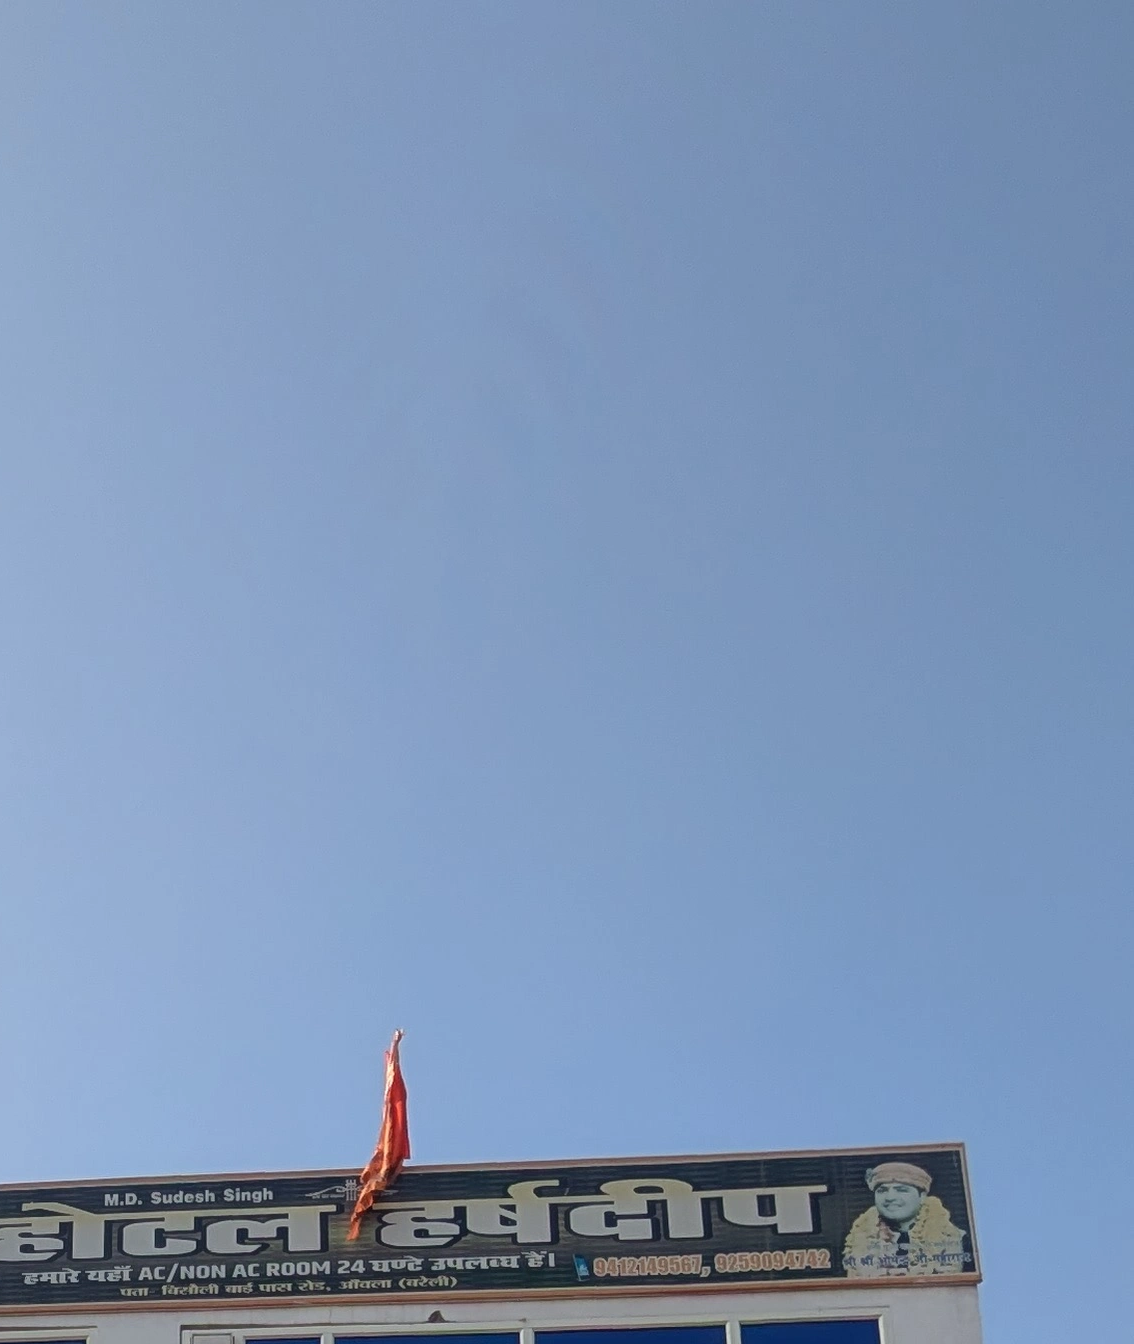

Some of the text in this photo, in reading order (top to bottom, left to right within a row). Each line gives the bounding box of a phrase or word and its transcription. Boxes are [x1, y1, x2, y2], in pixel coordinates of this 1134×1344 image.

[104, 1188, 273, 1207] M.D. Sudesh Singh
[372, 1178, 827, 1246] हर्षदीप
[22, 1267, 81, 1285] हमारे
[138, 1262, 226, 1283] AC/NON
[232, 1263, 260, 1278] AC
[266, 1260, 330, 1276] ROOM
[337, 1259, 365, 1274] 24
[368, 1255, 424, 1272] घण्टे
[428, 1255, 520, 1271] उपलब्ध
[714, 1249, 831, 1273] 9259094742
